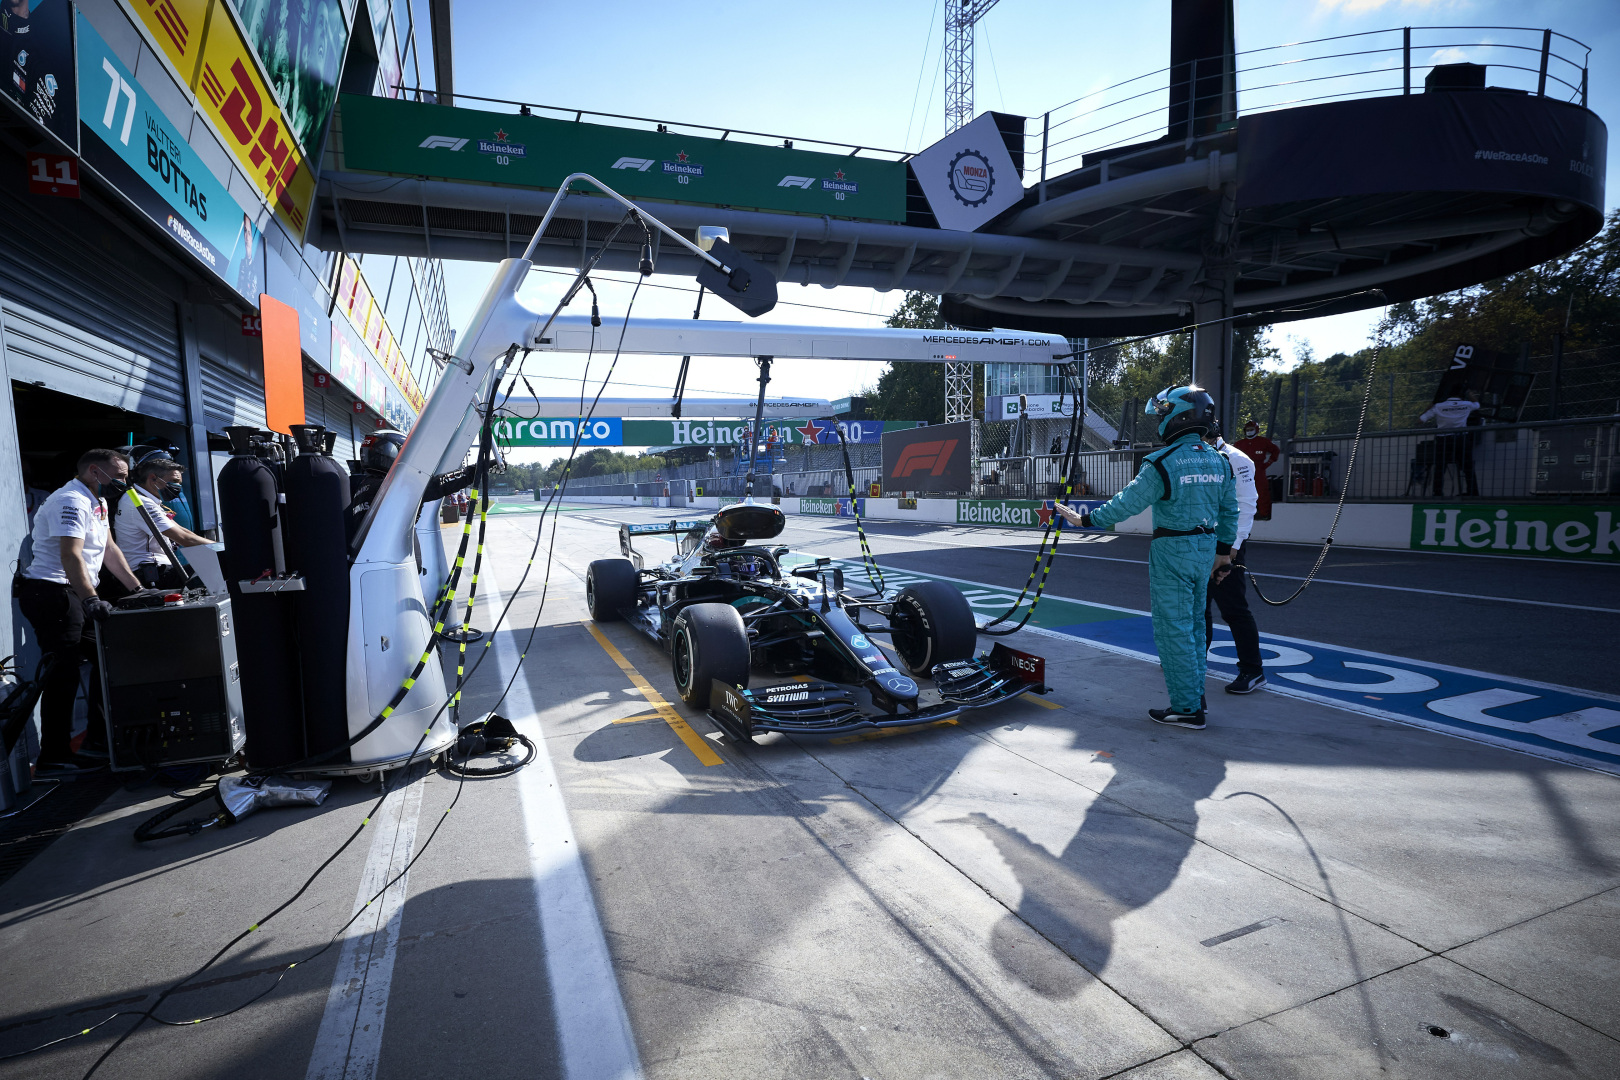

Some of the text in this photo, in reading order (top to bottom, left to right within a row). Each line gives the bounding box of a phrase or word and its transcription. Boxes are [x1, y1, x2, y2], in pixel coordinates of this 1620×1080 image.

[102, 56, 137, 147] 77
[145, 110, 182, 165] VALTTERI
[219, 57, 298, 217] DHL
[479, 141, 525, 155] Heineken
[1474, 150, 1549, 165] #WeRaceAsOne
[31, 158, 77, 186] 11
[147, 133, 208, 222] BOTTAS
[663, 163, 703, 175] Heineken
[963, 165, 988, 178] MONZA
[822, 180, 857, 192] Heineken
[173, 217, 216, 266] #WeRaceAsOne
[1450, 344, 1475, 370] VB
[318, 374, 326, 384] 9
[356, 402, 363, 410] 8
[493, 420, 611, 439] aramco
[1179, 473, 1225, 485] PETRONAS
[800, 499, 833, 514] Heineken
[958, 502, 1032, 525] Heineken
[906, 595, 930, 630] ZERO
[1011, 656, 1036, 673] INEOS
[765, 683, 809, 693] PETRONAS
[725, 690, 739, 711] IWC
[766, 691, 809, 703] SYNTIUM
